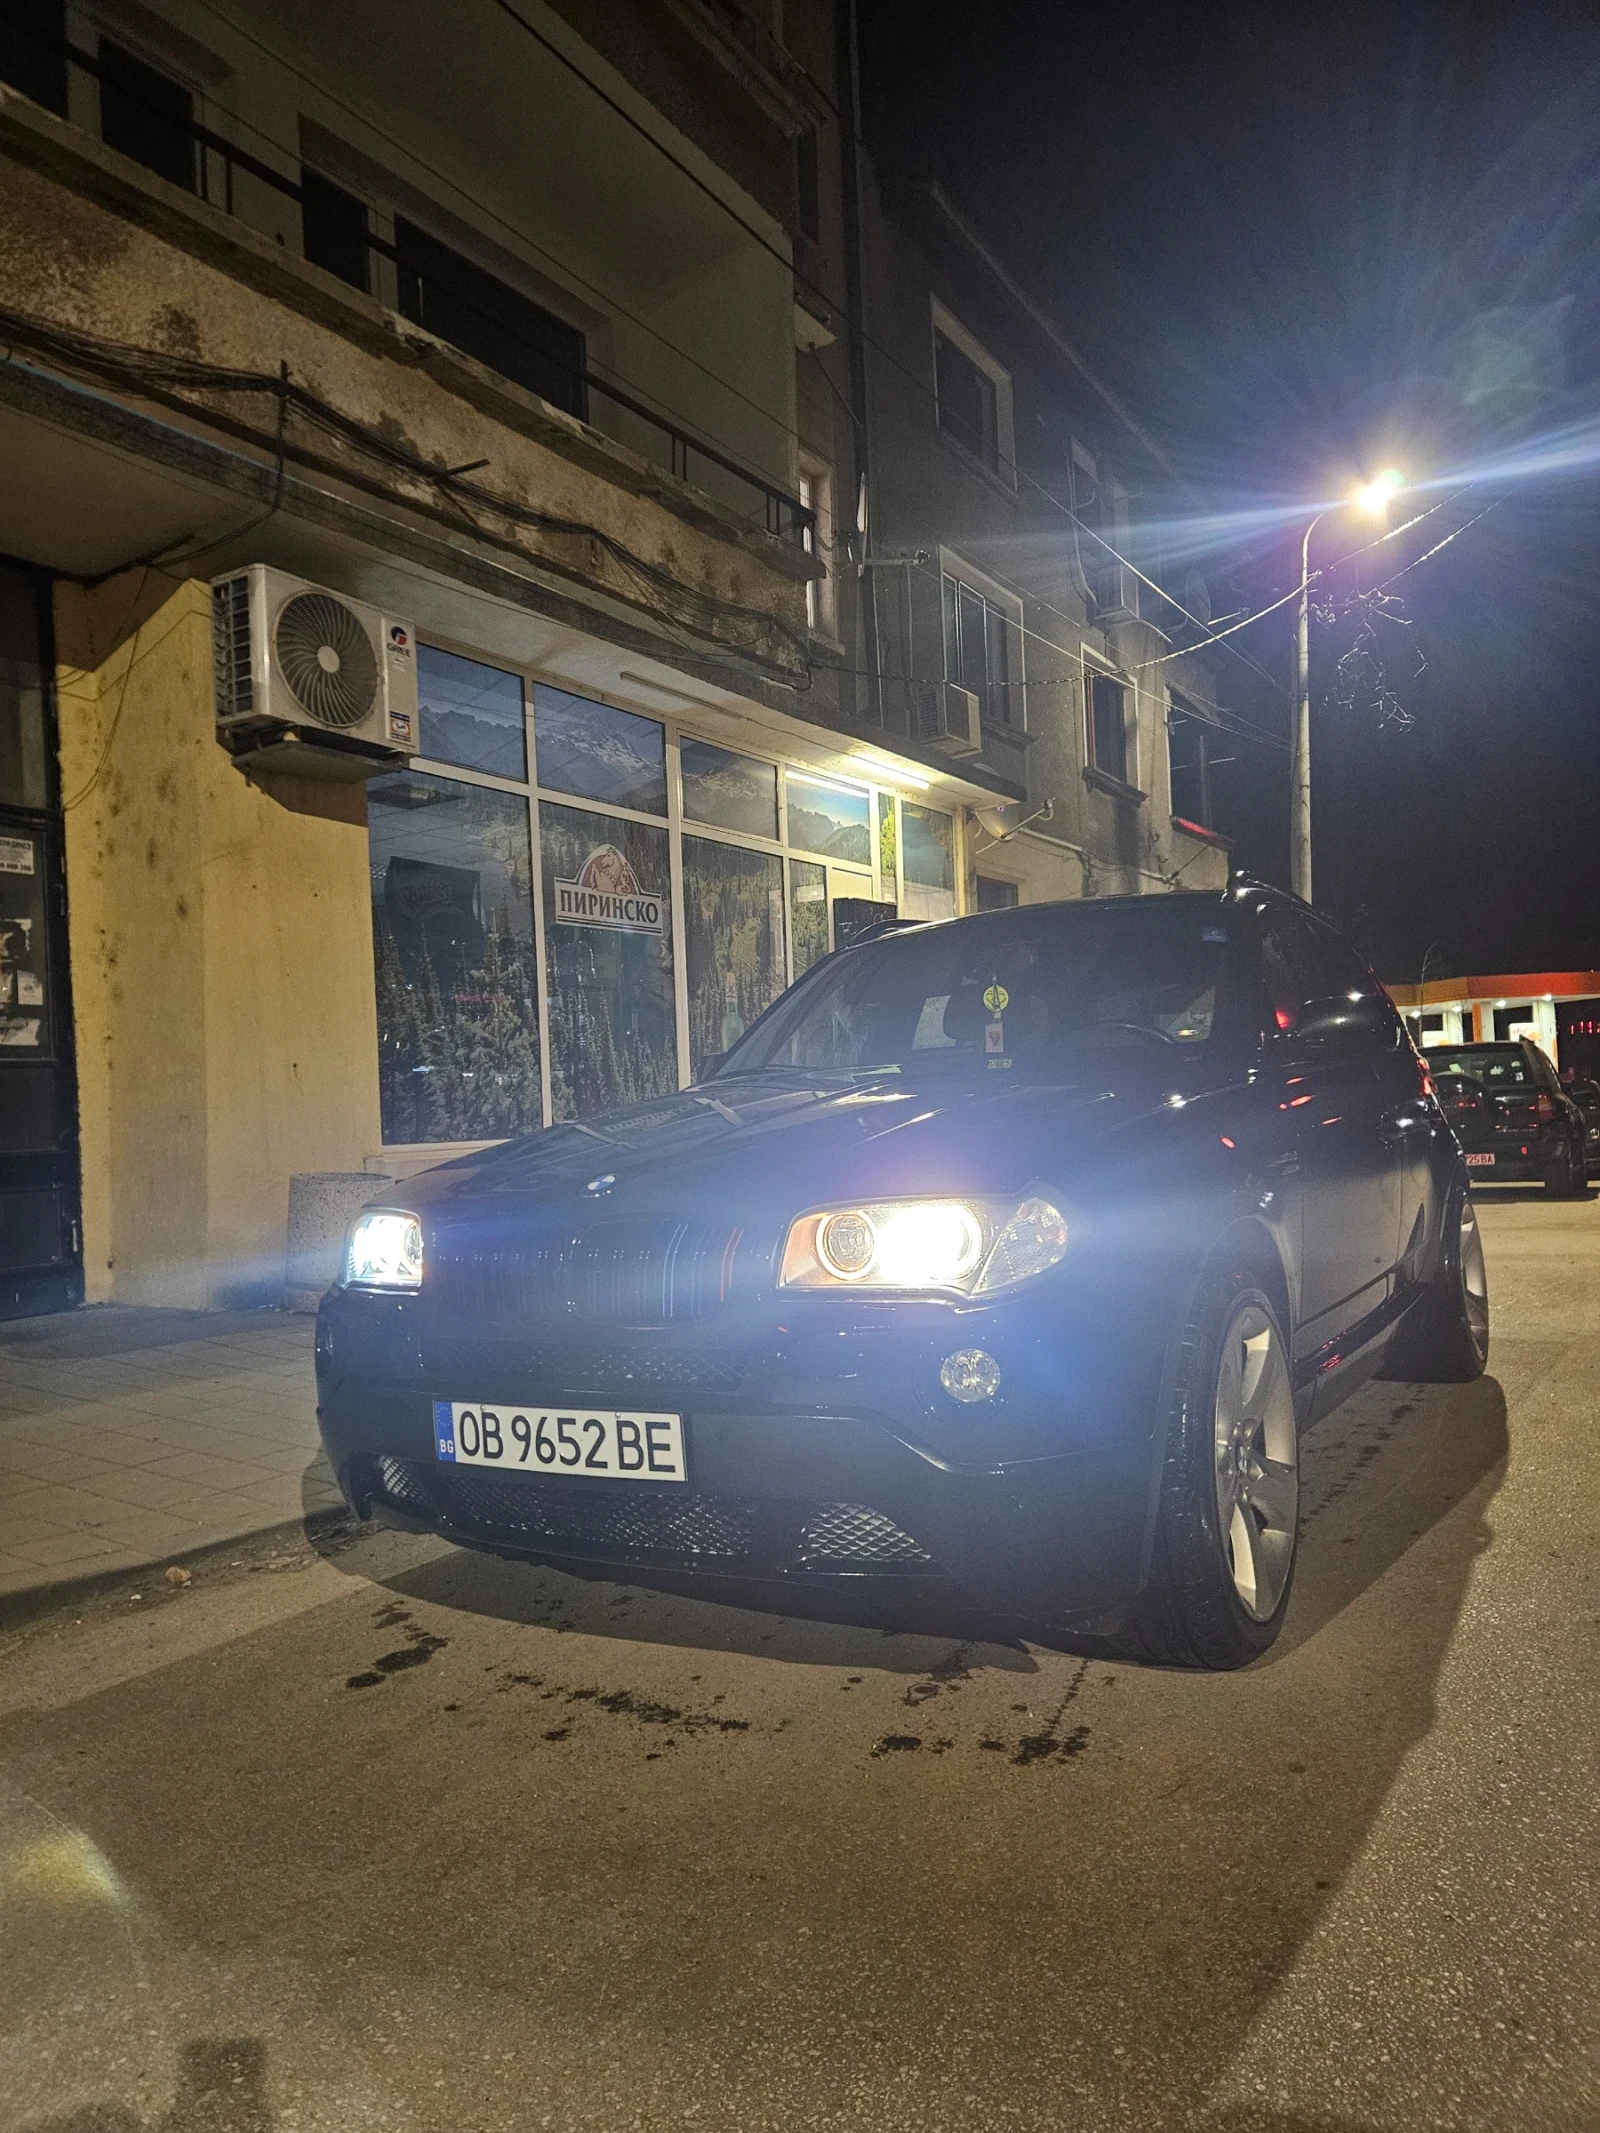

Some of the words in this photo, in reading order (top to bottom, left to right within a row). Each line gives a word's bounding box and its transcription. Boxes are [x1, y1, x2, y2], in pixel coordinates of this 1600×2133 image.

[560, 889, 659, 924] ПИРИНСКО
[1481, 1155, 1493, 1164] BA
[440, 1439, 454, 1454] BG
[459, 1410, 504, 1459] OB
[511, 1414, 608, 1469] 9652
[616, 1419, 676, 1473] BE
